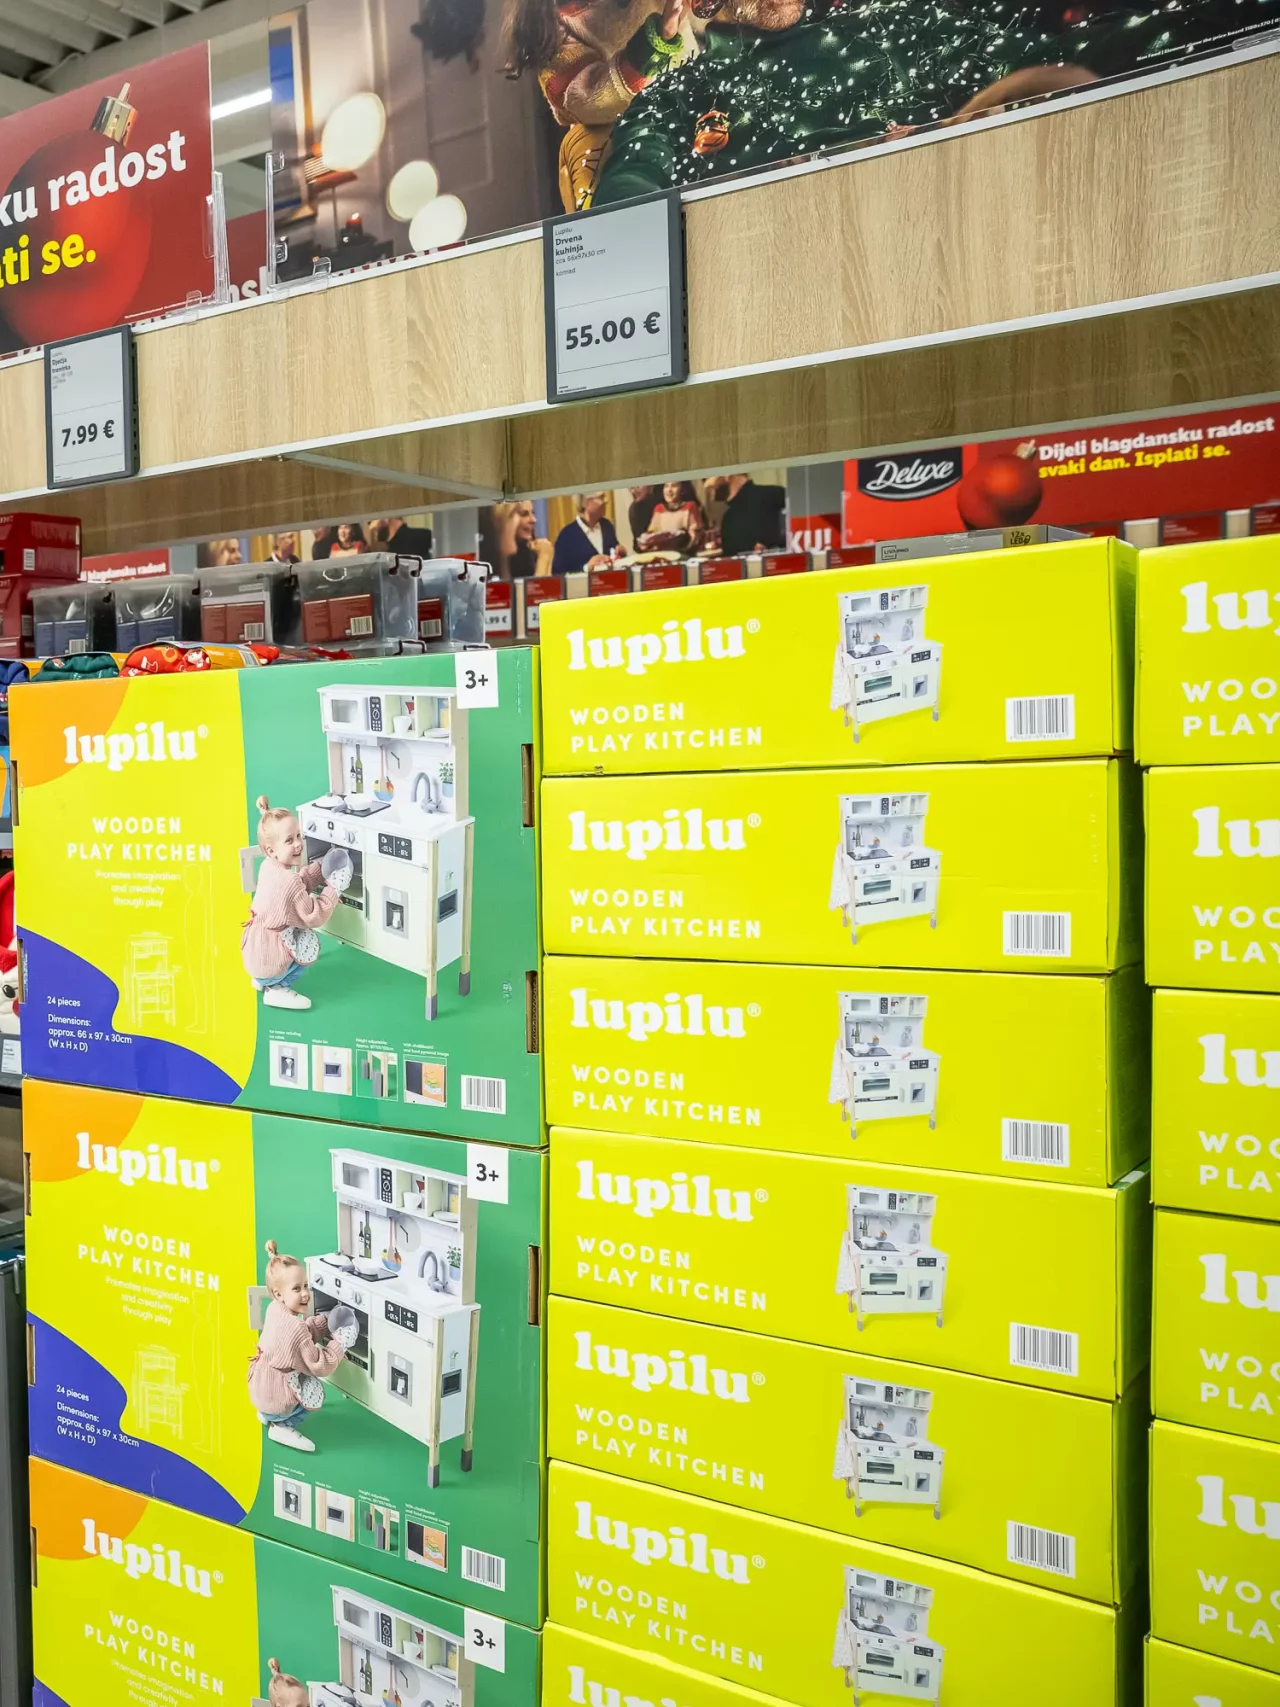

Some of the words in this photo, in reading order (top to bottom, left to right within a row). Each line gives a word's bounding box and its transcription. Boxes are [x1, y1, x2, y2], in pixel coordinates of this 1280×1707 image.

[48, 129, 187, 209] radost
[555, 235, 582, 245] Drvena
[556, 244, 583, 257] kuhinja
[41, 234, 97, 275] se.
[566, 317, 635, 350] 55.00
[643, 312, 660, 334] €
[62, 423, 97, 447] 7.99
[103, 420, 114, 438] €
[1039, 440, 1087, 461] Dijeli
[1091, 428, 1203, 454] blagdansku
[1207, 417, 1275, 439] radost
[1039, 458, 1086, 479] svaki
[1089, 456, 1131, 472] dan.
[1134, 443, 1199, 468] Isplati
[1202, 444, 1231, 458] se.
[866, 458, 955, 491] Deluxe
[464, 669, 489, 690] 3+
[569, 702, 685, 726] WOODEN
[571, 733, 633, 753] PLAY
[644, 727, 762, 751] KITCHEN
[92, 817, 181, 834] WOODEN
[67, 843, 114, 860] PLAY
[122, 843, 211, 861] KITCHEN
[112, 885, 127, 893] and
[569, 888, 684, 908] WOODEN
[113, 897, 144, 909] through
[145, 898, 163, 909] play
[570, 915, 632, 935] PLAY
[643, 917, 761, 939] KITCHEN
[47, 996, 56, 1005] 24
[58, 997, 81, 1008] pieces
[48, 1014, 92, 1027] Dimensions:
[48, 1027, 76, 1040] approx.
[77, 1030, 87, 1039] 66
[95, 1032, 104, 1041] 97
[111, 1034, 132, 1044] 30cm
[48, 1038, 60, 1049] (W
[66, 1041, 72, 1050] H
[79, 1042, 88, 1053] D)
[571, 1064, 684, 1091] WOODEN
[573, 1090, 633, 1113] PLAY
[645, 1097, 761, 1127] KITCHEN
[476, 1163, 500, 1183] 3+
[103, 1225, 191, 1259] WOODEN
[577, 1235, 691, 1270] WOODEN
[78, 1244, 125, 1268] PLAY
[132, 1256, 220, 1291] KITCHEN
[121, 1293, 136, 1304] and
[577, 1262, 636, 1289] PLAY
[649, 1275, 767, 1311] KITCHEN
[123, 1306, 153, 1321] through
[154, 1312, 172, 1326] play
[56, 1384, 65, 1393] 24
[66, 1388, 90, 1402] pieces
[56, 1402, 99, 1423] Dimensions:
[56, 1425, 68, 1436] (W
[74, 1431, 81, 1441] H
[87, 1435, 97, 1447] D)
[57, 1415, 84, 1430] approx.
[85, 1423, 95, 1433] 66
[102, 1428, 112, 1438] 97
[119, 1435, 140, 1448] 30cm
[575, 1405, 688, 1445] WOODEN
[576, 1430, 635, 1458] PLAY
[648, 1446, 764, 1491] KITCHEN
[575, 1571, 687, 1620] WOODEN
[108, 1610, 195, 1659] WOODEN
[473, 1628, 496, 1650] 3+
[576, 1596, 635, 1628] PLAY
[648, 1619, 763, 1671] KITCHEN
[84, 1623, 130, 1654] PLAY
[138, 1646, 224, 1695] KITCHEN
[126, 1678, 142, 1690] and
